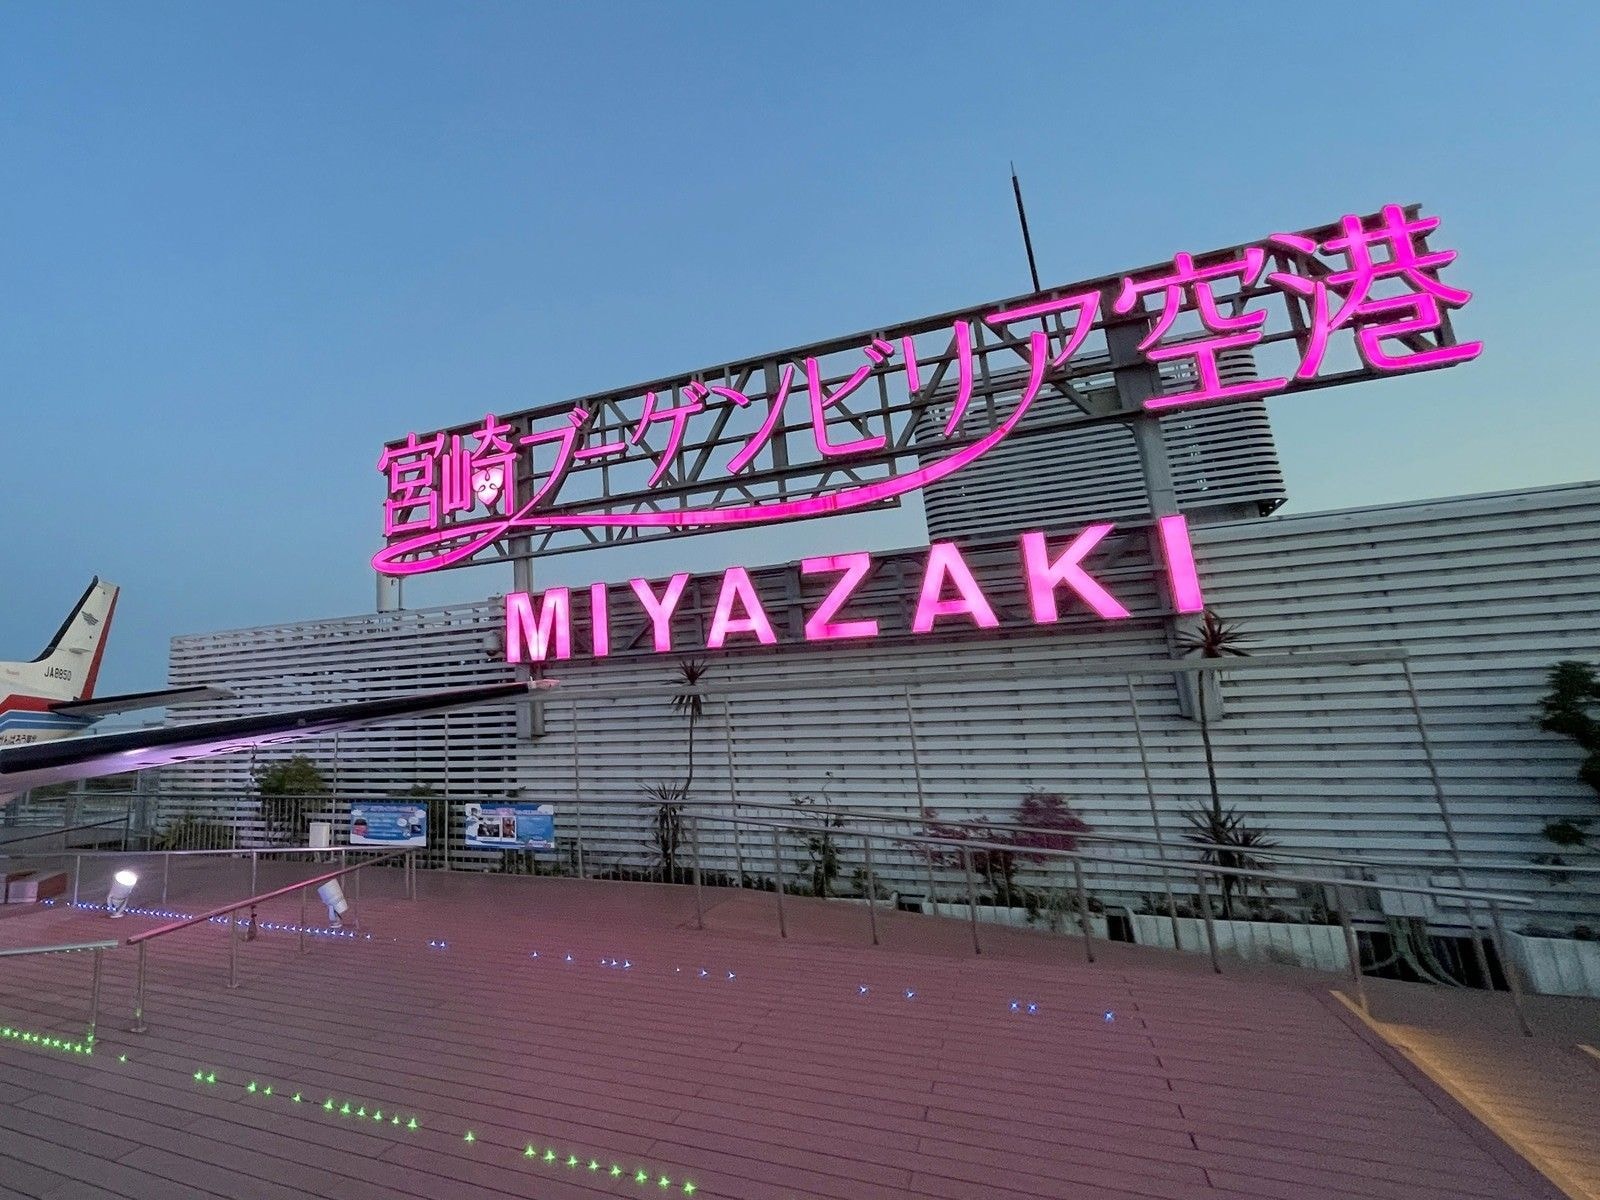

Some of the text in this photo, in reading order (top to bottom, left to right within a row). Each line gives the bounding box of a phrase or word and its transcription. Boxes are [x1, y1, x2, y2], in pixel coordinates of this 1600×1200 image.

[371, 203, 1483, 575] 宮崎ブーゲンビリア空港
[506, 514, 1205, 664] MIYAZAKI
